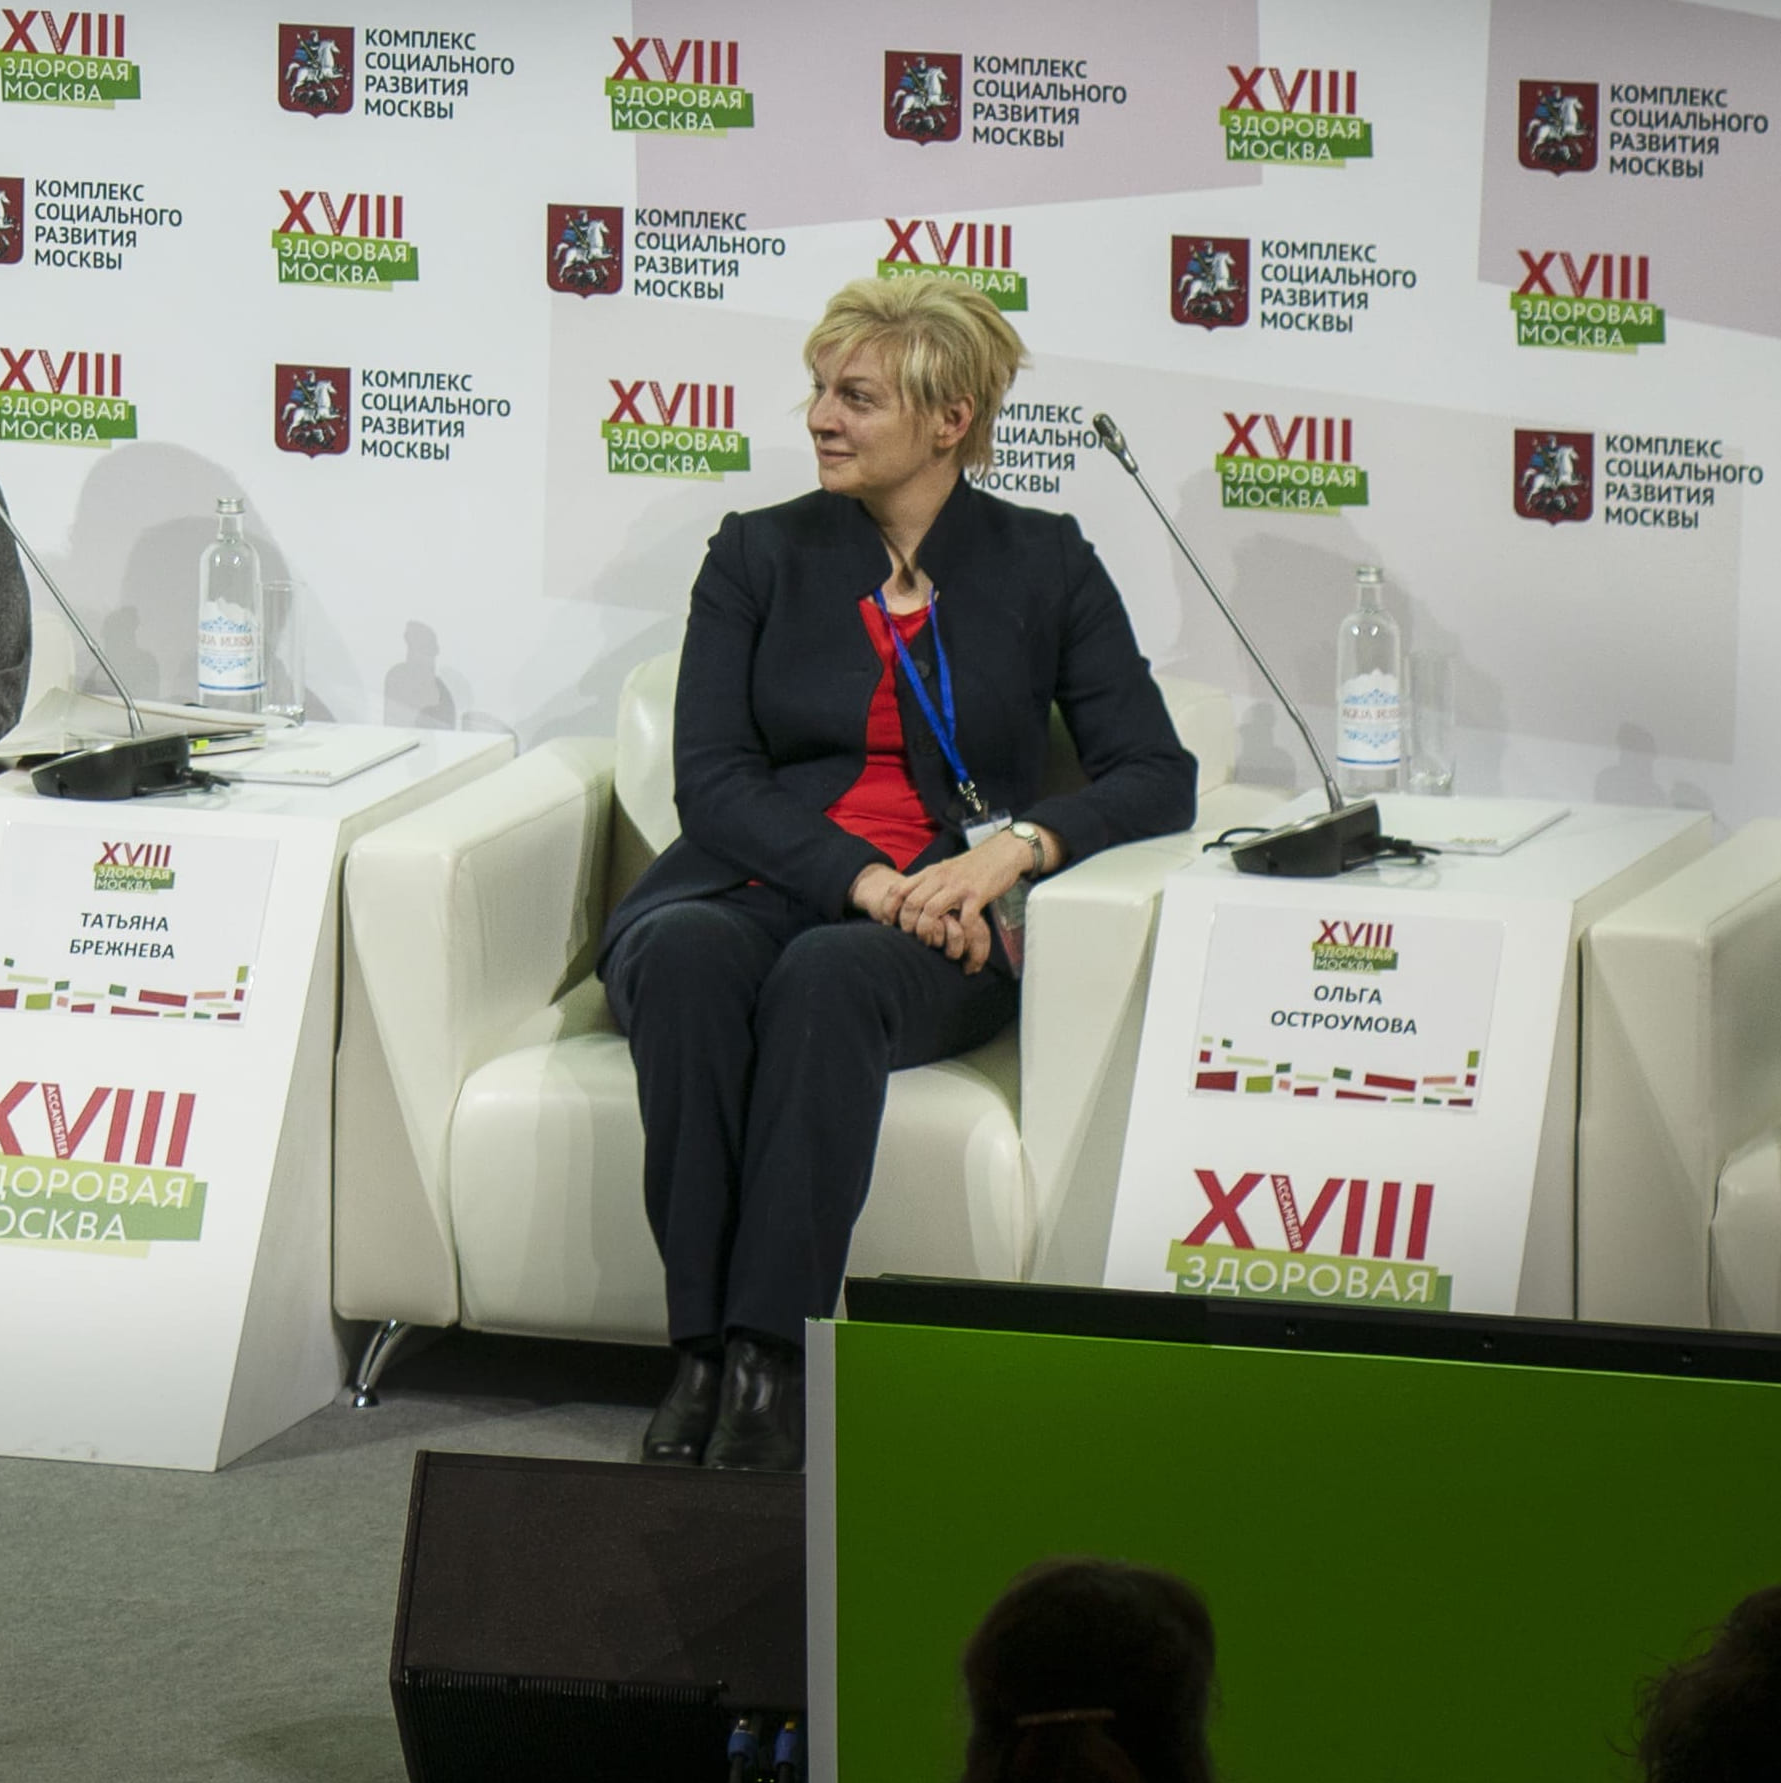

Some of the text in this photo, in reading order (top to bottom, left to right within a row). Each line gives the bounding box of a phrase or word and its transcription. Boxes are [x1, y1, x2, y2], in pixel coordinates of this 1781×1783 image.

[613, 37, 737, 86] XVIII
[973, 55, 1088, 79] КОМПЛЕКС
[614, 87, 743, 109] ЗДОРОВАЯ
[972, 78, 1128, 105] СОЦИАЛЬНОГО
[615, 110, 716, 130] МОСКВА
[972, 101, 1080, 126] РАЗВИТИЯ
[972, 125, 1065, 148] МОСКВЫ
[280, 190, 401, 239] XVIII
[634, 208, 747, 232] КОМПЛЕКС
[281, 239, 407, 261] ЗДОРОВАЯ
[634, 231, 786, 257] СОЦИАЛЬНОГО
[282, 262, 381, 282] МОСКВА
[634, 254, 739, 278] РАЗВИТИЯ
[1518, 250, 1648, 301] XVIII
[634, 278, 724, 300] МОСКВЫ
[1519, 303, 1654, 327] ЗДОРОВАЯ
[1520, 327, 1626, 349] МОСКВА
[0, 348, 120, 397] XVIII
[361, 369, 473, 393] КОМПЛЕКС
[1, 397, 126, 419] ЗДОРОВАЯ
[361, 392, 512, 418] СОЦИАЛЬНОГО
[2, 419, 100, 439] МОСКВА
[361, 415, 465, 438] РАЗВИТИЯ
[1223, 413, 1350, 463] XVIII
[361, 438, 450, 461] МОСКВЫ
[1224, 465, 1356, 488] ЗДОРОВАЯ
[1225, 489, 1329, 510] МОСКВА
[98, 841, 171, 867] XVIII
[97, 866, 171, 881] ЗДОРОВАЯ
[81, 912, 169, 932] ТАТЬЯНА
[1317, 920, 1393, 947] XVIII
[69, 939, 175, 959] БРЕЖНЕВА
[1313, 983, 1383, 1005] ОЛЬГА
[1270, 1009, 1418, 1036] ОСТРОУМОВА
[46, 1084, 69, 1157] АССАМБЛЕЯ
[1181, 1168, 1435, 1260] XVIII
[1274, 1176, 1304, 1250] АССАМБЛЕЯ
[1182, 1254, 1432, 1304] ЗДОРОВАЯ
